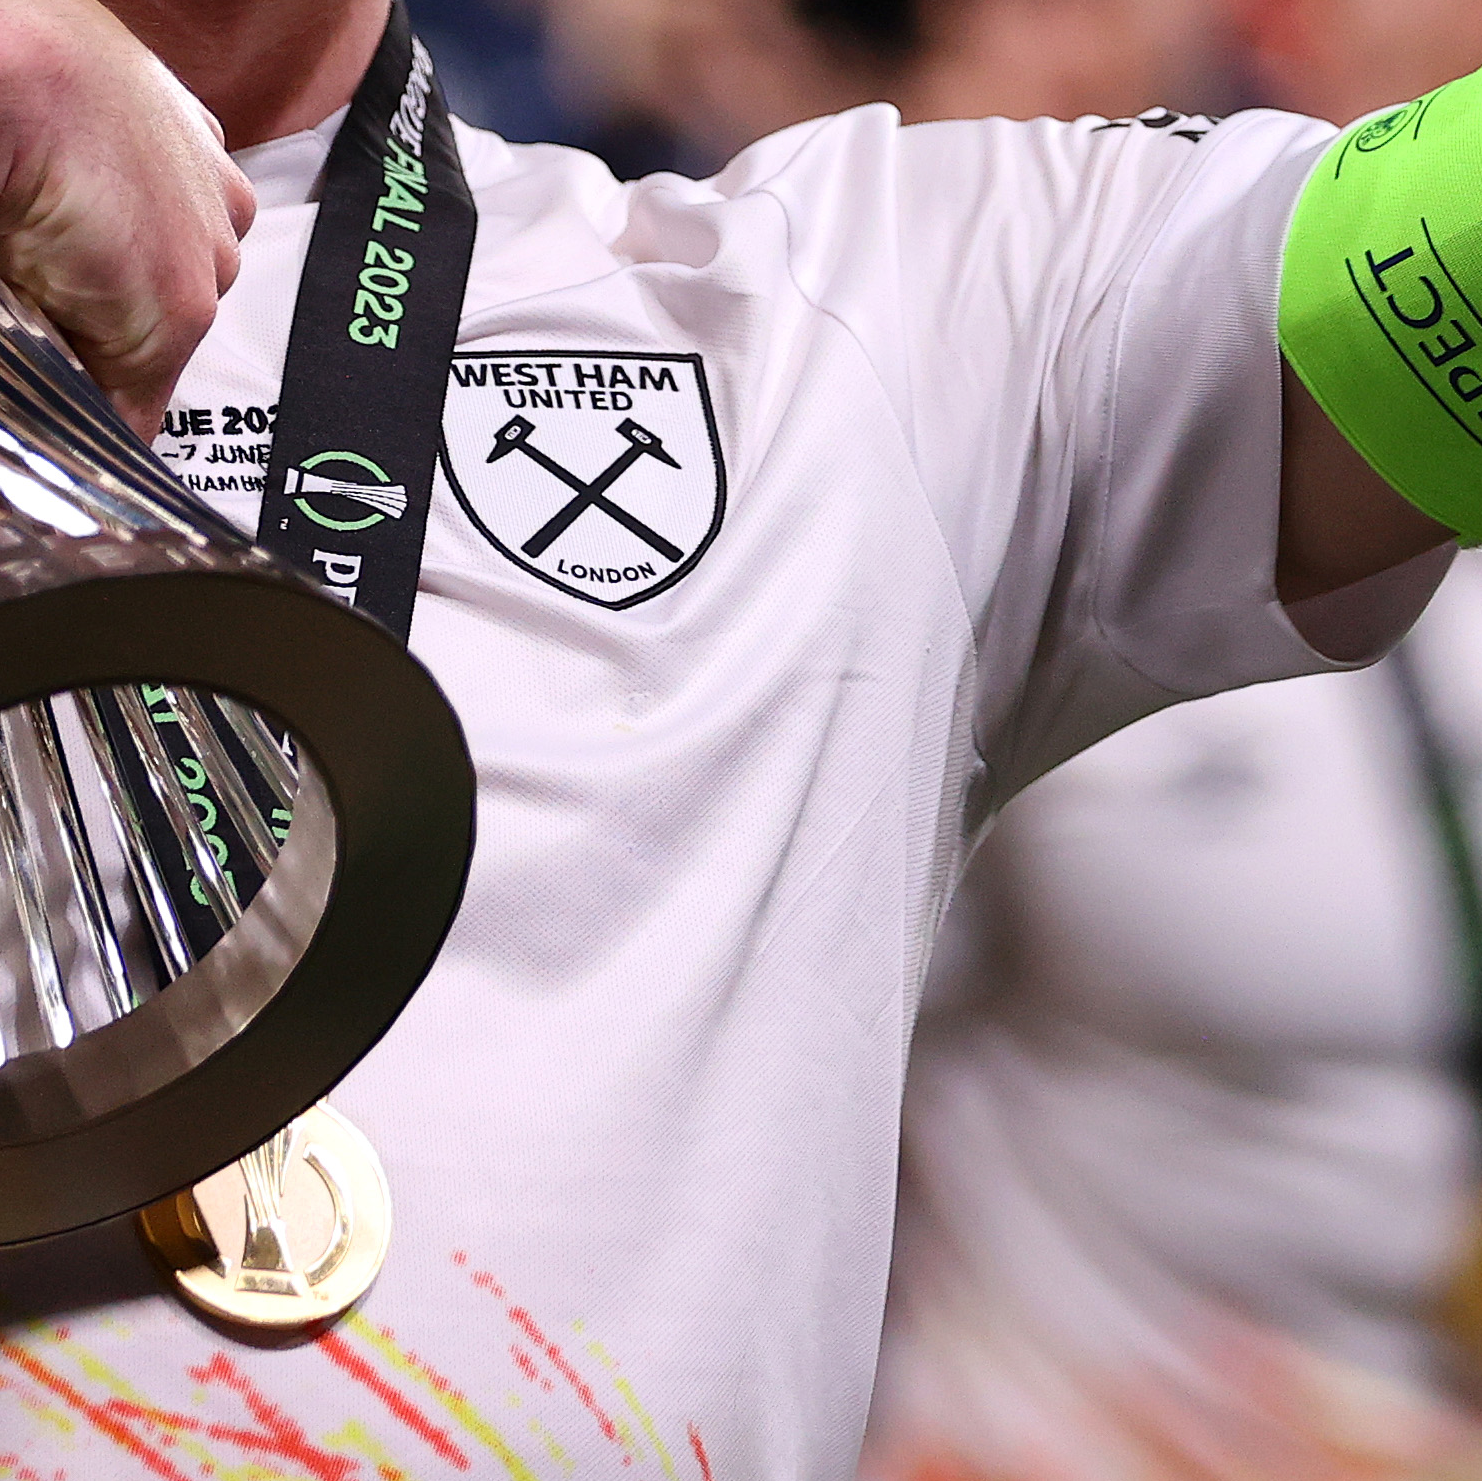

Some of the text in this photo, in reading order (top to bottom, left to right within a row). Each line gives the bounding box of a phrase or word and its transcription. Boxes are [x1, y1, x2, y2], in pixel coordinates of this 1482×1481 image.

[347, 240, 416, 350] 2023
[450, 362, 680, 392] WEST HAM
[505, 389, 634, 411] UNITED
[160, 408, 215, 437] UE
[205, 444, 271, 464] JUNE
[556, 559, 657, 584] LONDON
